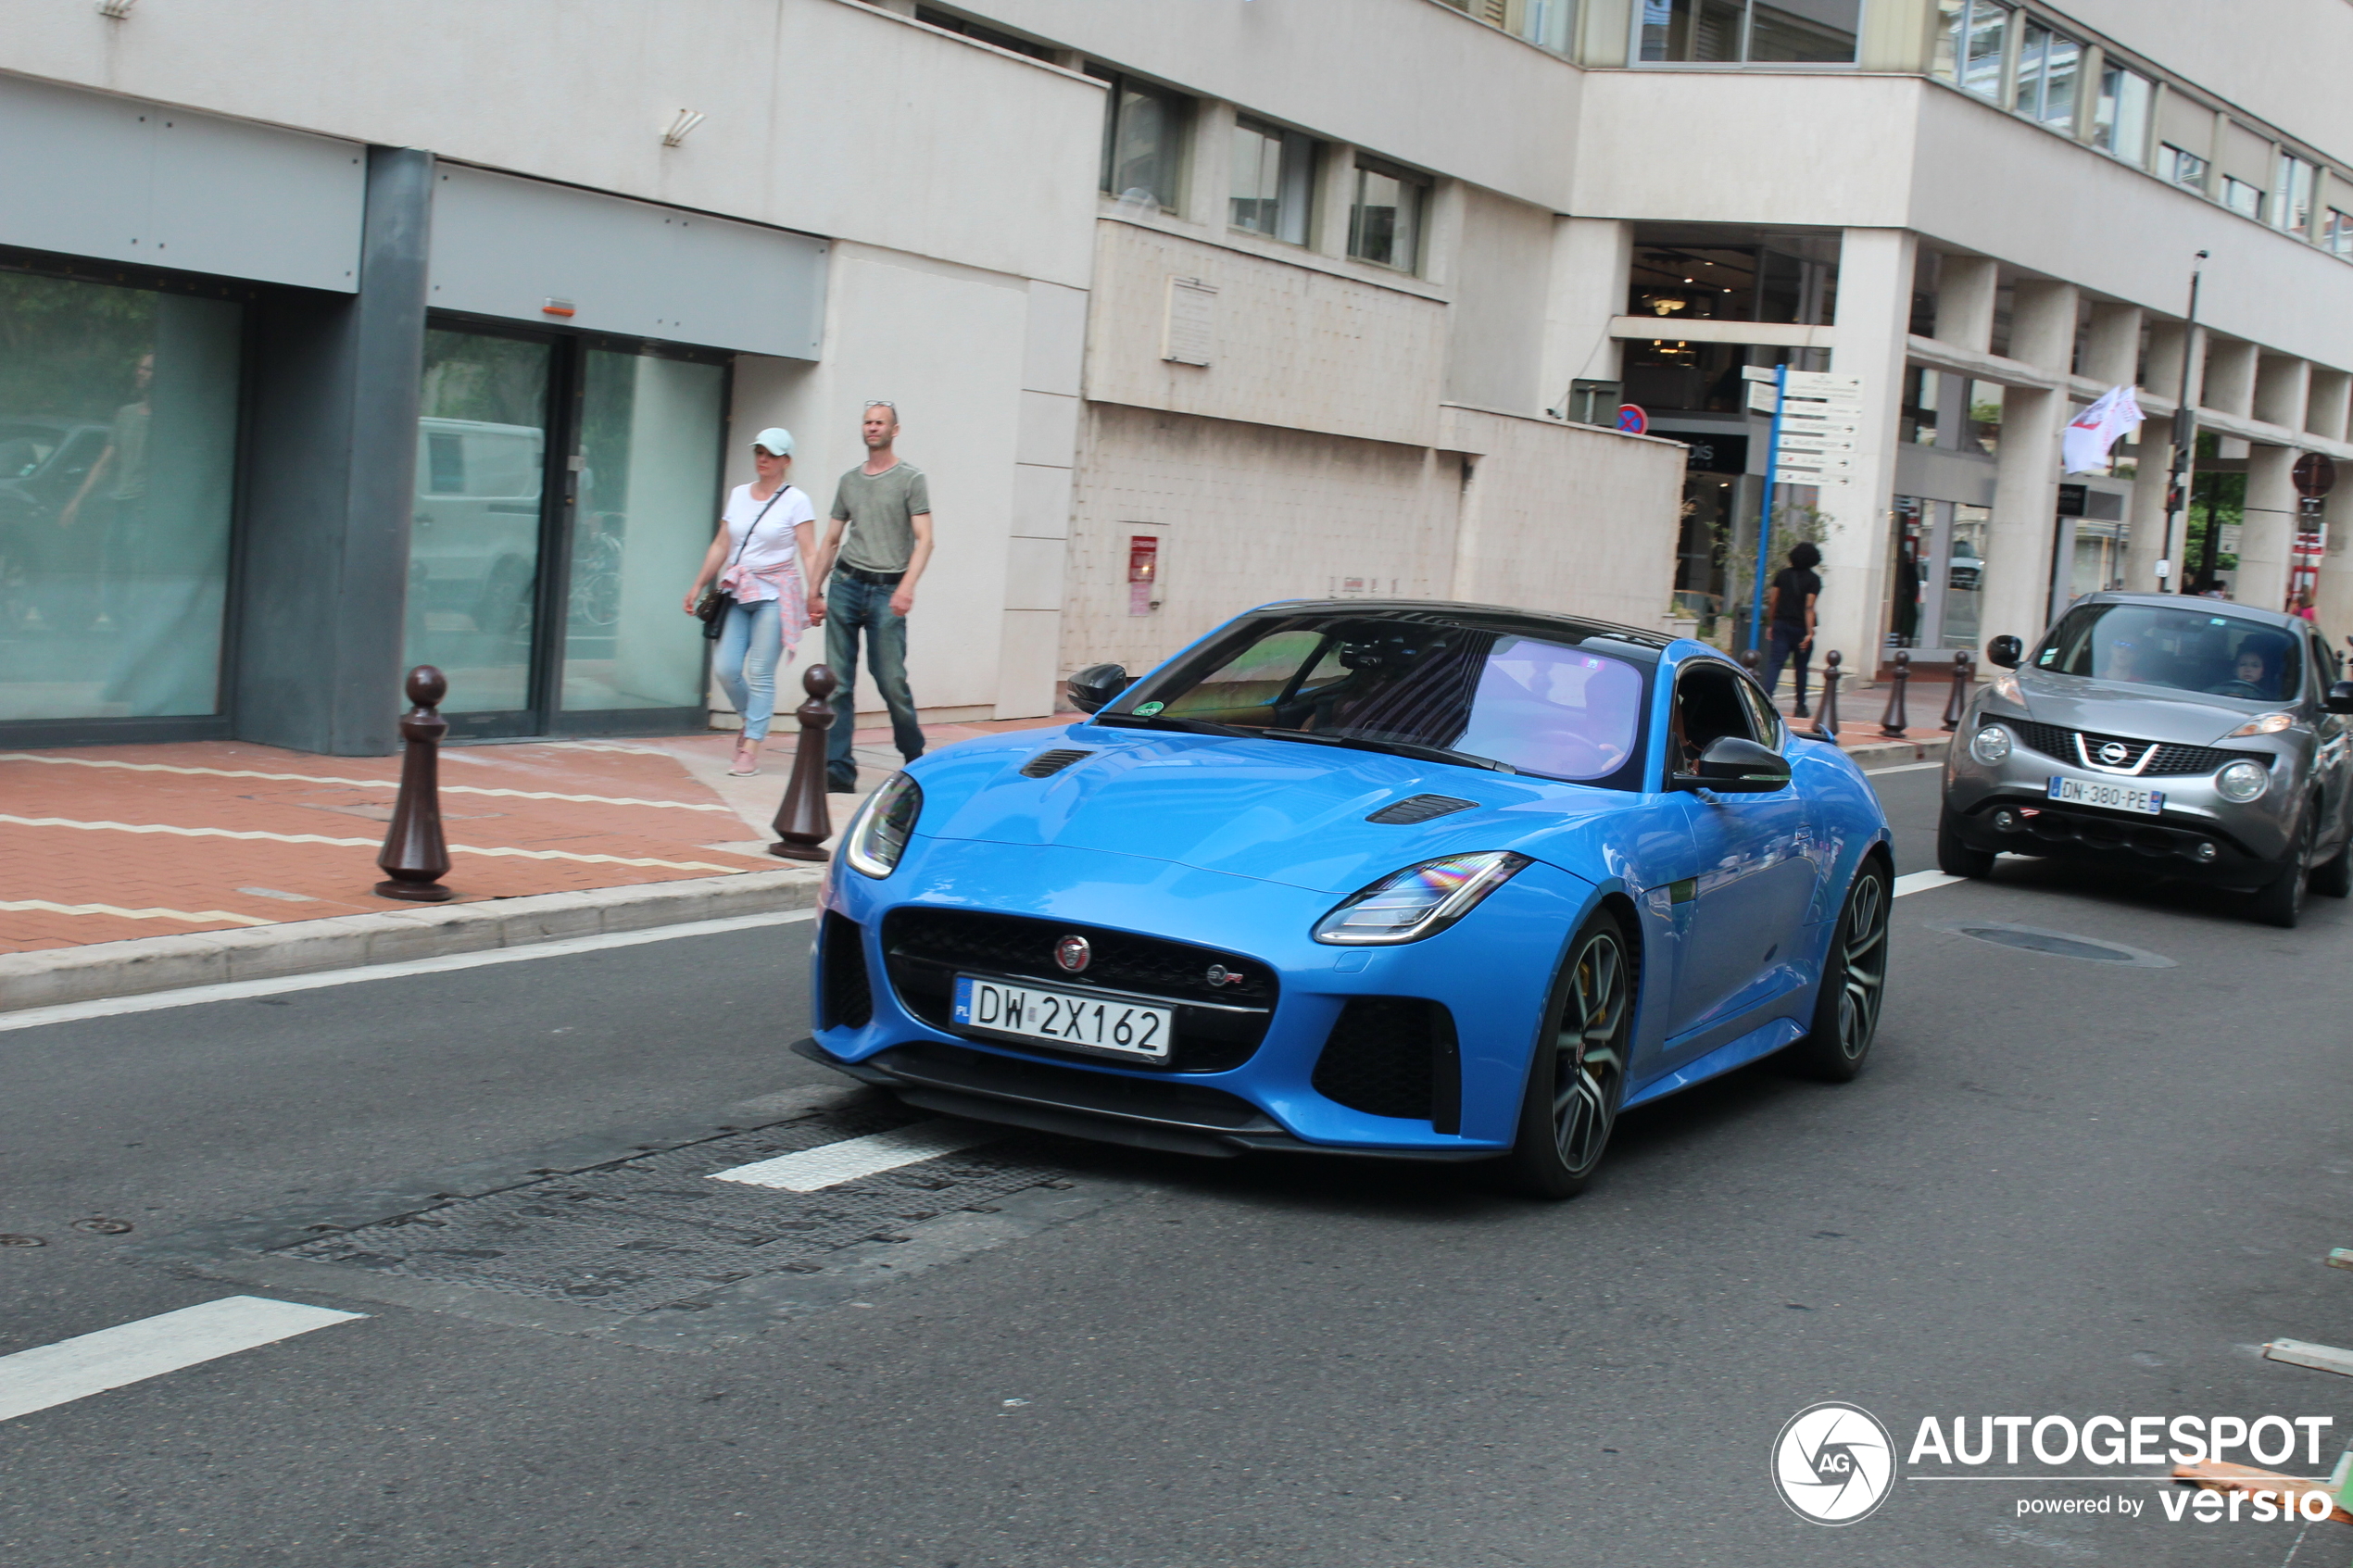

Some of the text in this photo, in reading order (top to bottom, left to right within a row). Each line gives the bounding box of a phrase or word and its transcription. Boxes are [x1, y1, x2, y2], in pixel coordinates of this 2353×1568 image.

[2062, 781, 2147, 809] DN-380-PE
[955, 1005, 970, 1017] PL
[978, 985, 1160, 1051] DW 2X162
